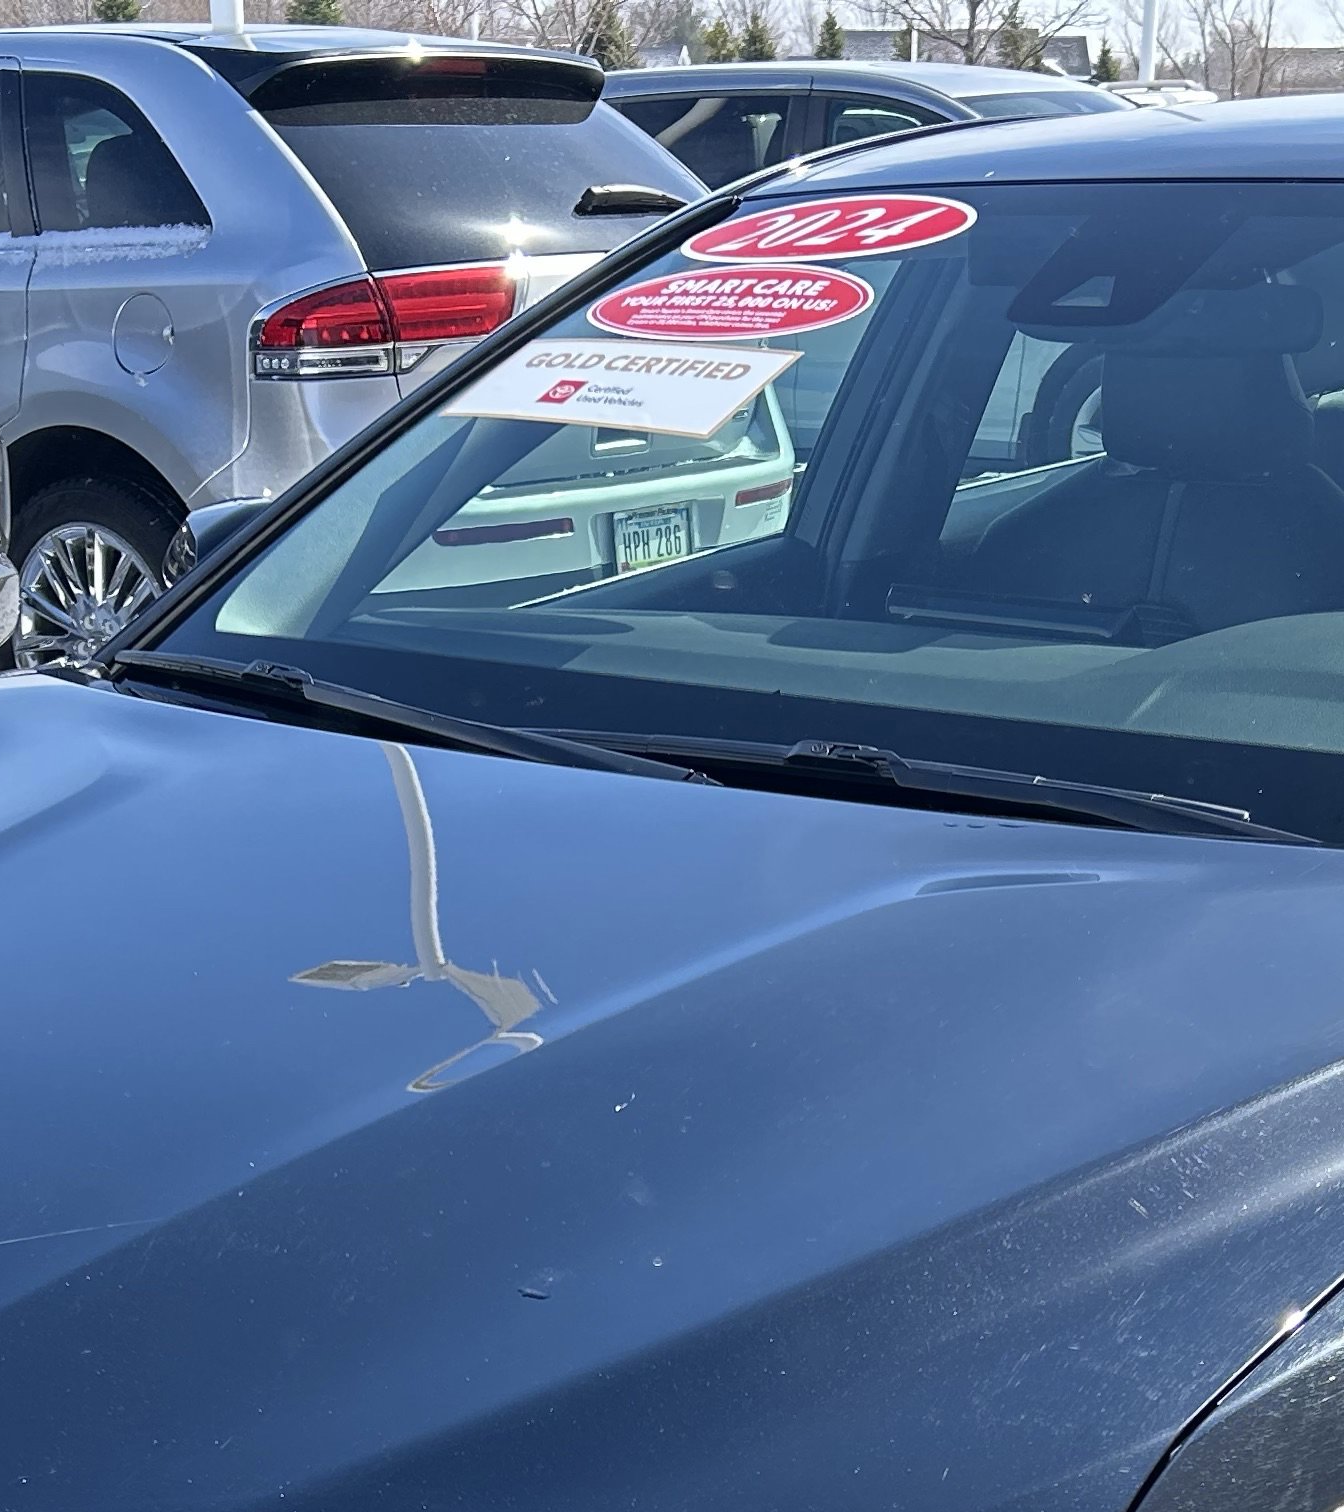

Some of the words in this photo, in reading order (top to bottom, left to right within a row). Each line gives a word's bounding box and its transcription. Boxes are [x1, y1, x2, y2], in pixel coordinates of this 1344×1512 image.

[706, 206, 949, 253] 2024
[661, 278, 758, 294] SMART
[753, 279, 831, 296] CARE
[621, 296, 668, 307] YOUR
[666, 295, 717, 307] FIRST
[711, 296, 773, 308] 25,000
[772, 297, 805, 309] ON
[802, 298, 838, 312] US!
[525, 352, 606, 370] GOLD
[604, 355, 752, 381] CERTIFIED
[588, 384, 633, 395] Certified
[576, 394, 604, 404] Used
[604, 396, 643, 407] Vehicles
[656, 524, 682, 558] 286
